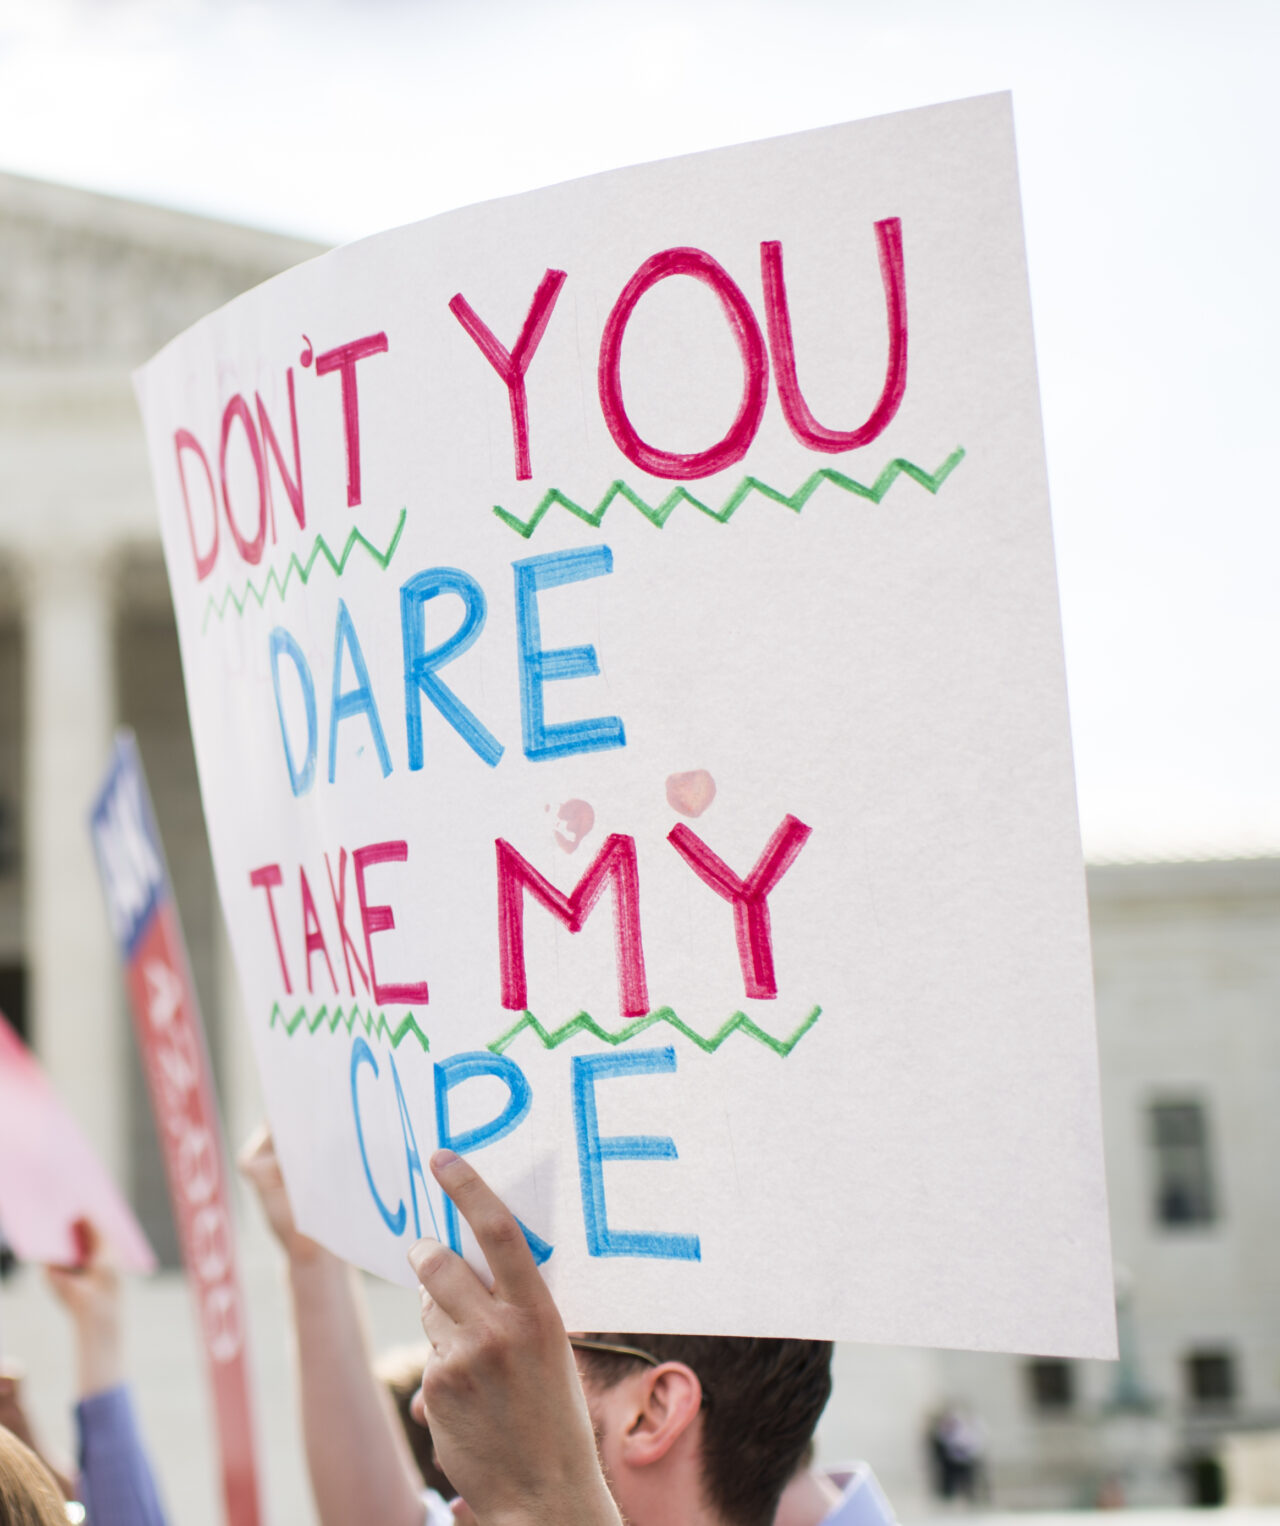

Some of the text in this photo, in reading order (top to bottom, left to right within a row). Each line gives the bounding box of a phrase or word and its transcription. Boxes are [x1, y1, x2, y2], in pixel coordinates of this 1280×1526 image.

[174, 216, 909, 581] DON'T YOU
[269, 543, 628, 798] DARE
[248, 839, 430, 1007] TAKE
[493, 813, 814, 1019] MY
[349, 1036, 703, 1268] CARE
